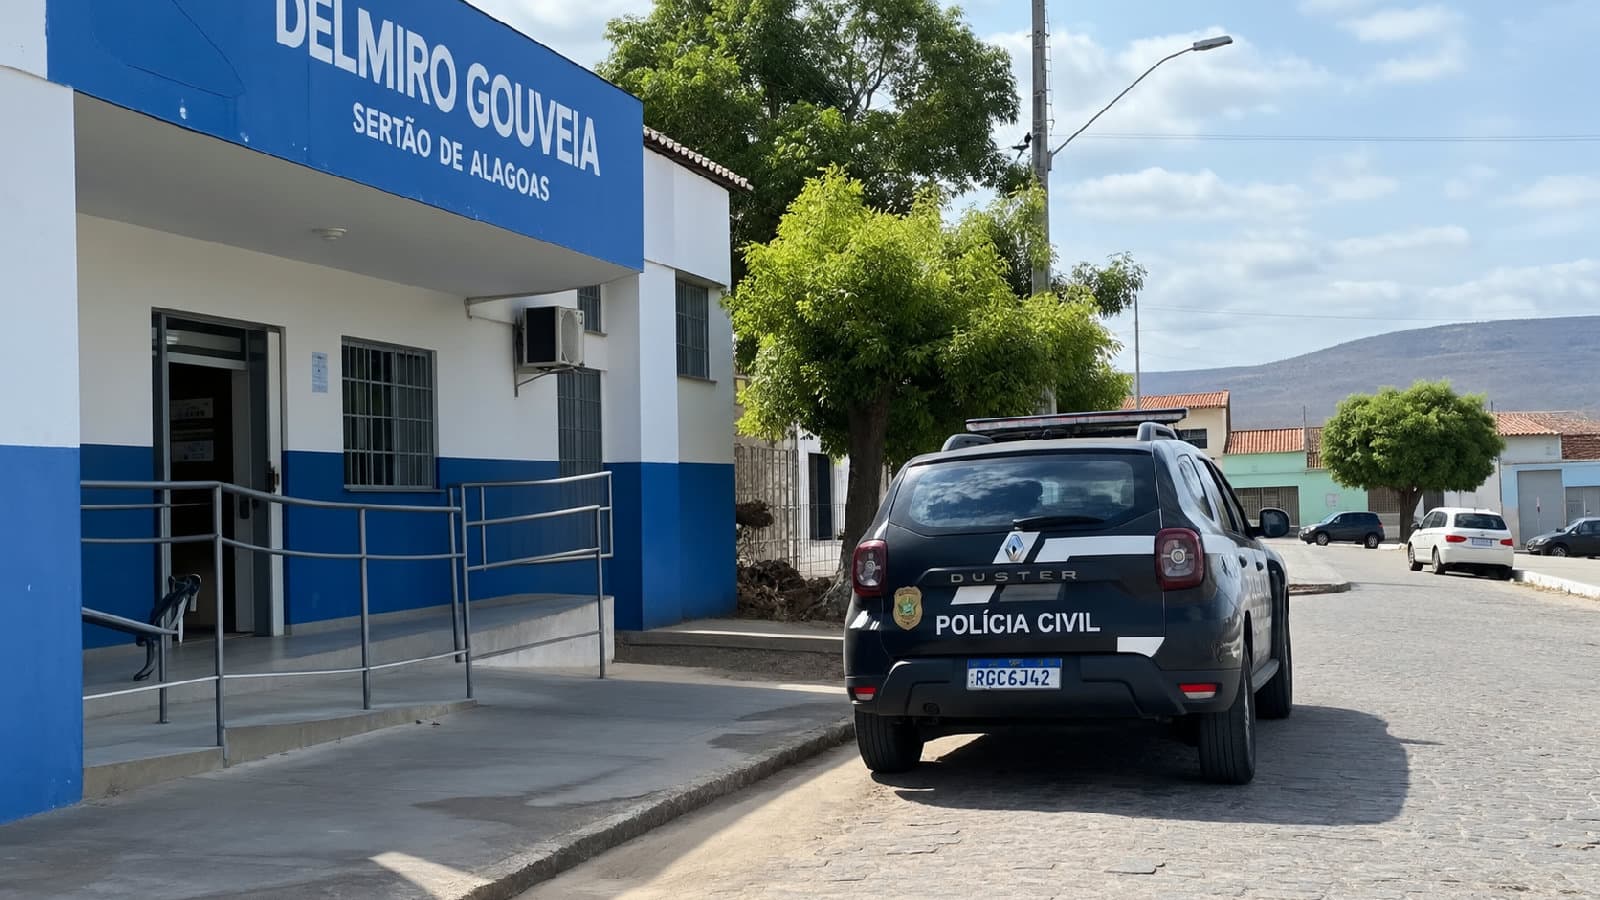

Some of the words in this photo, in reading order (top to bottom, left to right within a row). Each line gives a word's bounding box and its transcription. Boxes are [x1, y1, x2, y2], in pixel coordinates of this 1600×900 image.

[276, 0, 457, 113] DELMIRO
[467, 63, 600, 176] GOUVEIA
[353, 102, 431, 158] SERTÃO
[440, 137, 463, 171] DE
[470, 150, 549, 201] ALAGOAS
[950, 570, 1077, 583] DUSTER
[936, 609, 1030, 635] POLÍCIA
[1037, 612, 1100, 633] CIVIL
[976, 670, 1050, 686] RGC6J42
